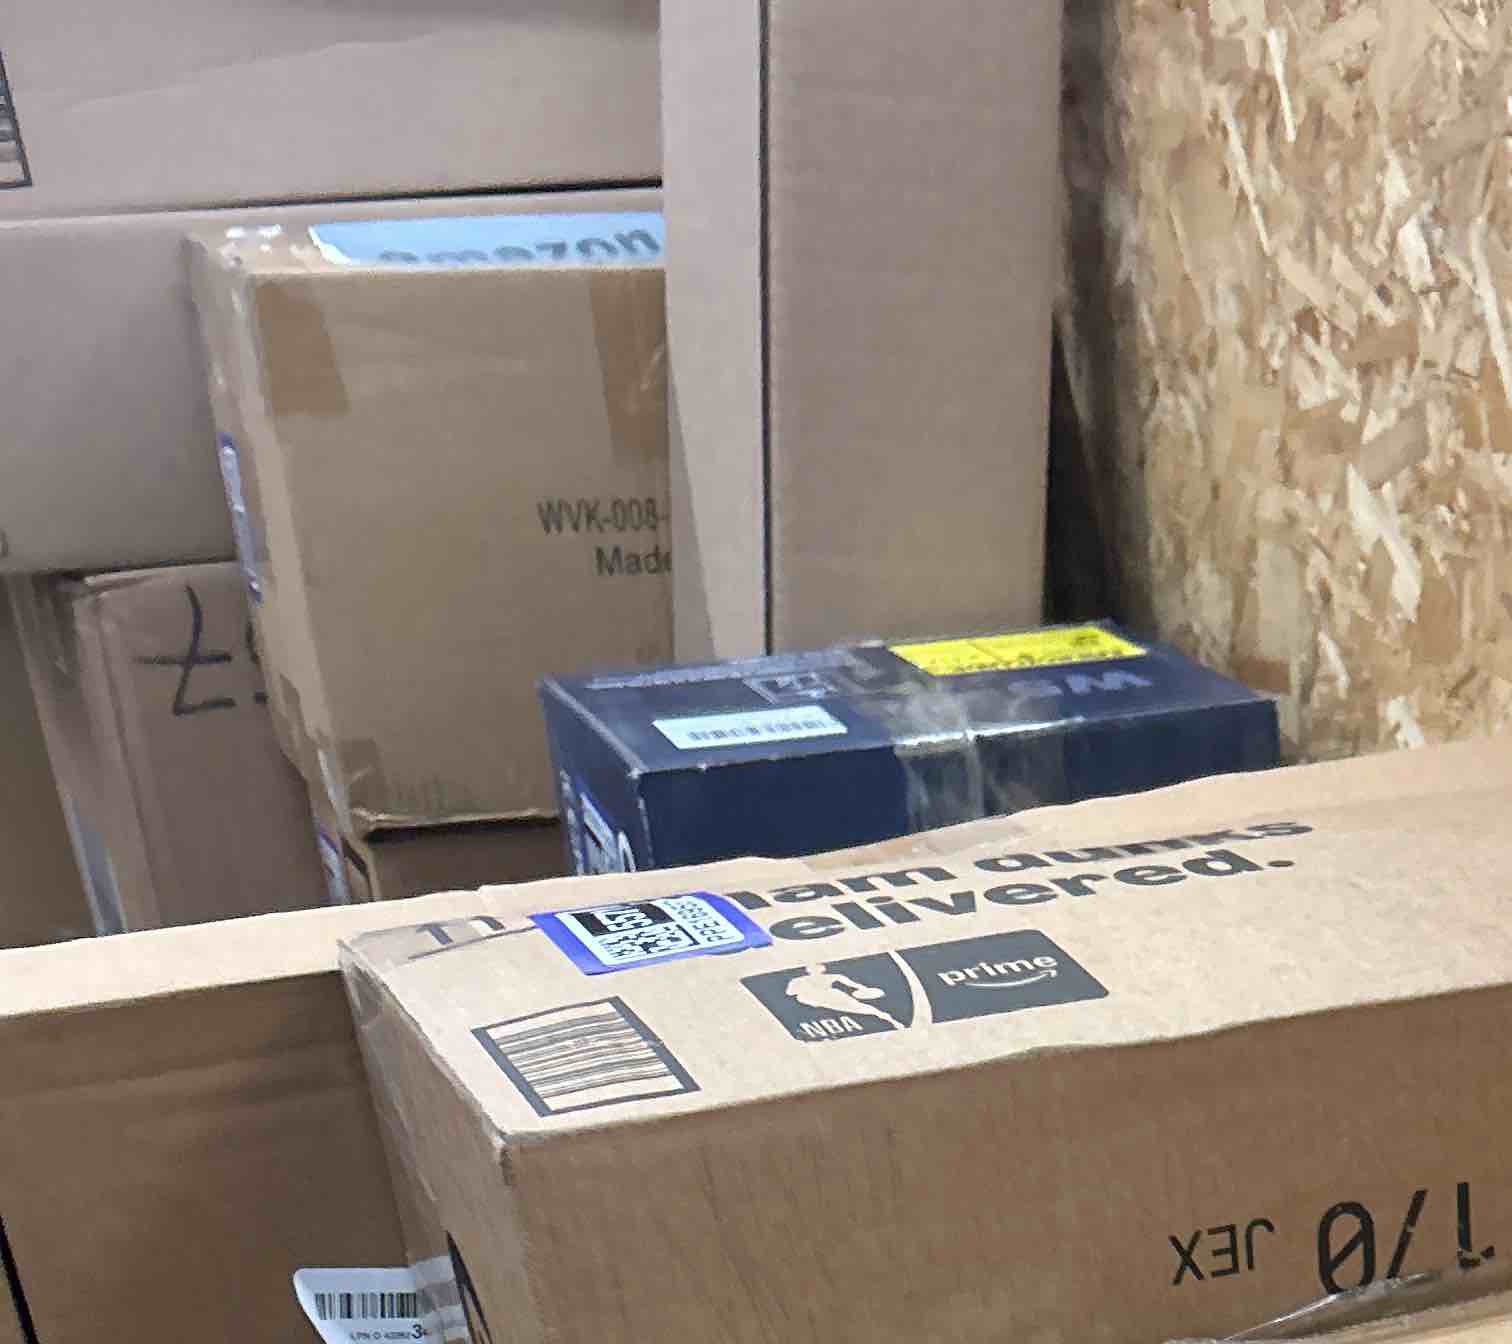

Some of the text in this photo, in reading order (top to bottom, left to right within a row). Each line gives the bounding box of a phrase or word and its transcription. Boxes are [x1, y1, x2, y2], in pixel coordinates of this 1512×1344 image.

[769, 849, 1294, 941] elivered.
[938, 953, 1059, 987] prime
[799, 1015, 863, 1040] NBA
[1168, 1218, 1275, 1286] JEX
